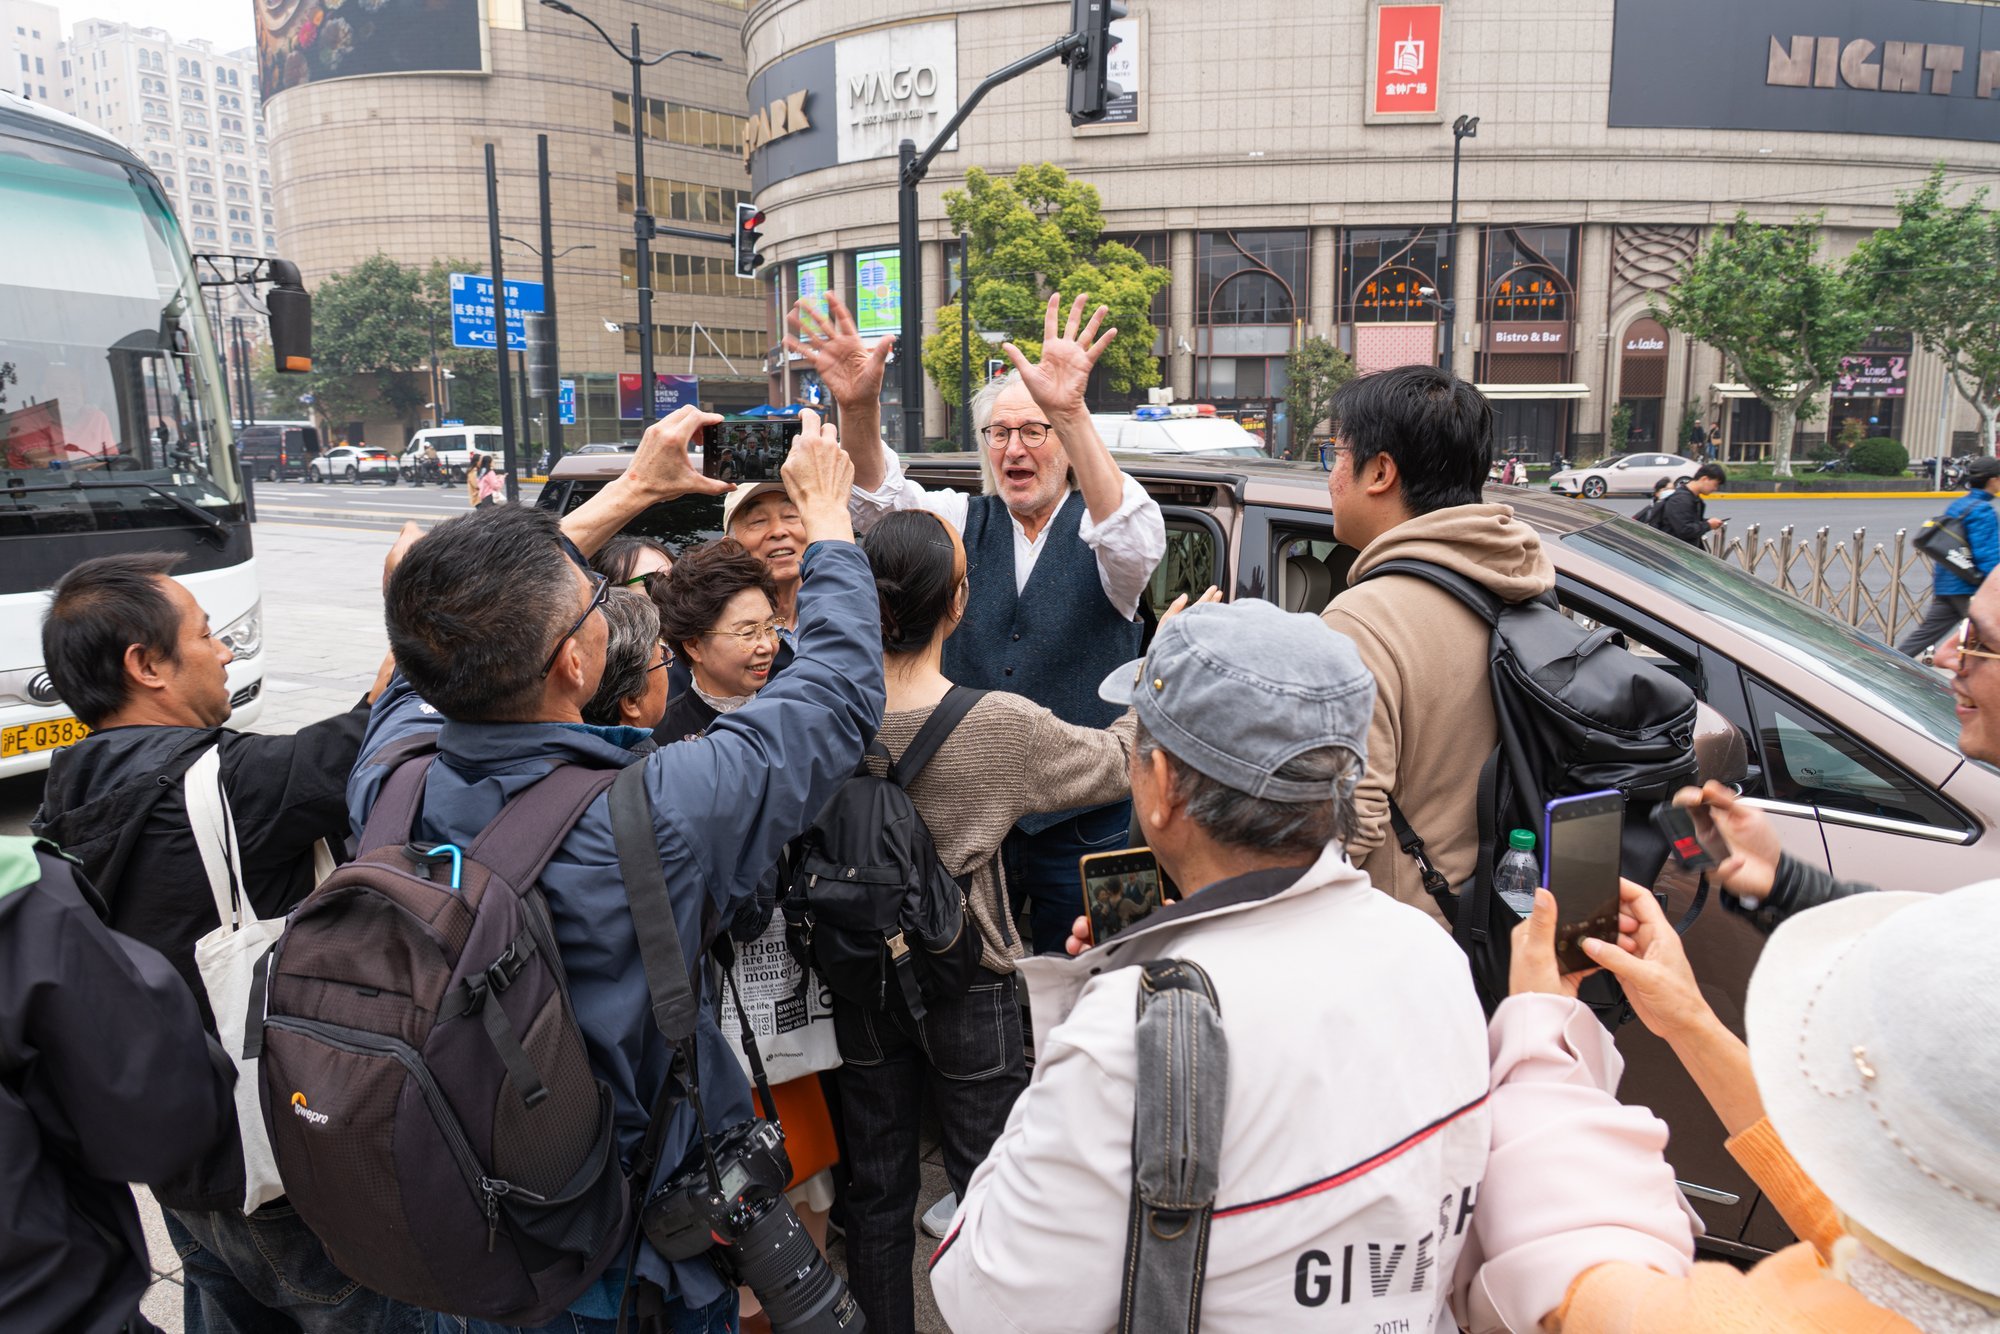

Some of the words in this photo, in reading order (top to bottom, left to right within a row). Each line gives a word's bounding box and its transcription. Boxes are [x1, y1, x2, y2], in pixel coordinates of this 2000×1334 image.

[1766, 34, 1965, 95] NIGHT
[849, 65, 937, 109] MAGO
[1385, 83, 1428, 96] 金钟广场
[1495, 331, 1528, 342] Bistro
[1530, 331, 1541, 342] &
[1542, 331, 1561, 342] Bar
[654, 389, 680, 398] SHENG
[3, 721, 87, 753] 沪E·Q383
[742, 955, 763, 966] are
[743, 962, 780, 974] important
[744, 966, 793, 983] money
[757, 1002, 772, 1011] life.
